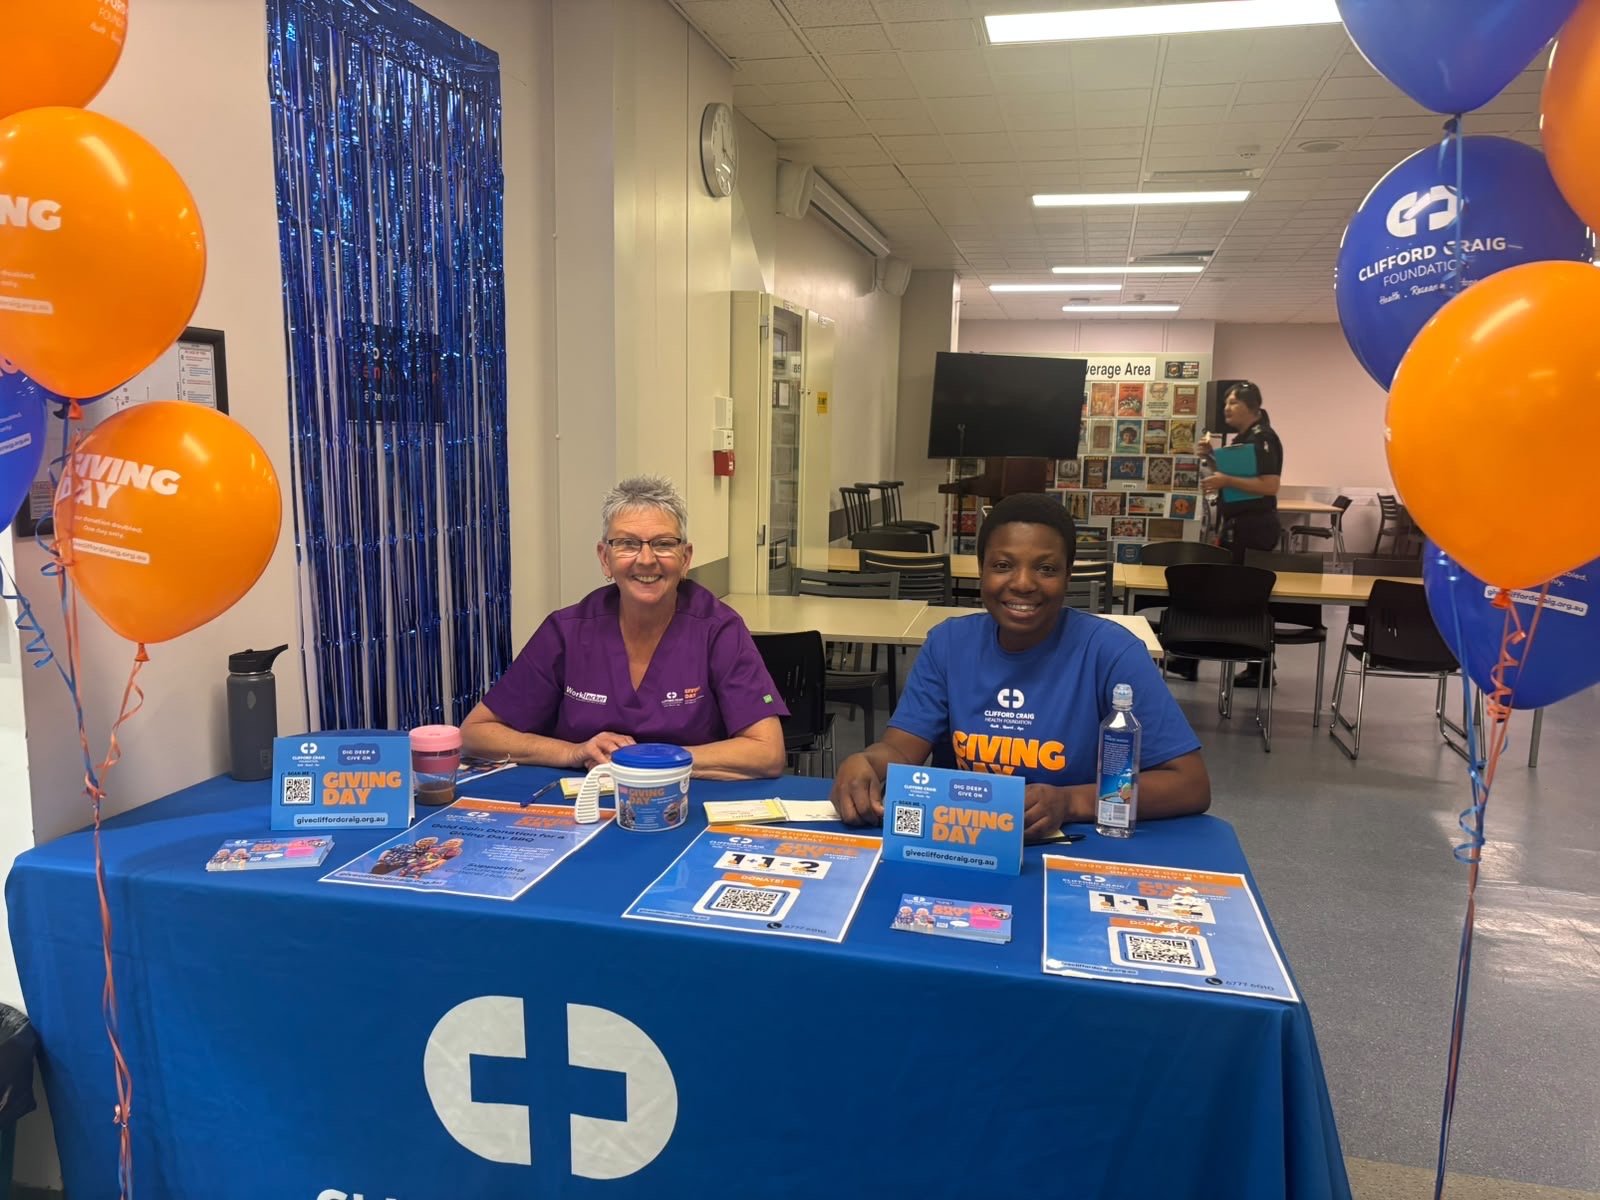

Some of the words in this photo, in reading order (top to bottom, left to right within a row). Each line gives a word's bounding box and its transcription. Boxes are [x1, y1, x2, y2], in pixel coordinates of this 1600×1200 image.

[1358, 245, 1437, 282] CLIFFORD
[1384, 260, 1458, 286] FOUNDATIO
[1085, 363, 1121, 379] verage
[1124, 362, 1151, 376] Area
[984, 710, 1015, 718] CLIFFORD
[953, 730, 1066, 771] GIVING
[323, 771, 402, 788] GIVING
[323, 788, 371, 806] DAY
[296, 816, 386, 825] givecliffordcraig.org.au
[933, 805, 1014, 832] GIVING
[450, 830, 485, 839] Giving
[487, 833, 509, 841] Day
[487, 828, 537, 837] Donation
[762, 829, 812, 838] DONATION
[932, 824, 981, 845] DAY
[731, 853, 745, 865] 1
[761, 856, 775, 868] 1
[798, 861, 820, 873] 2
[905, 850, 995, 866] givecliffordcraig.org.au
[467, 862, 526, 872] Supporting
[1105, 865, 1156, 874] DONATION
[741, 875, 784, 884] DONATE!
